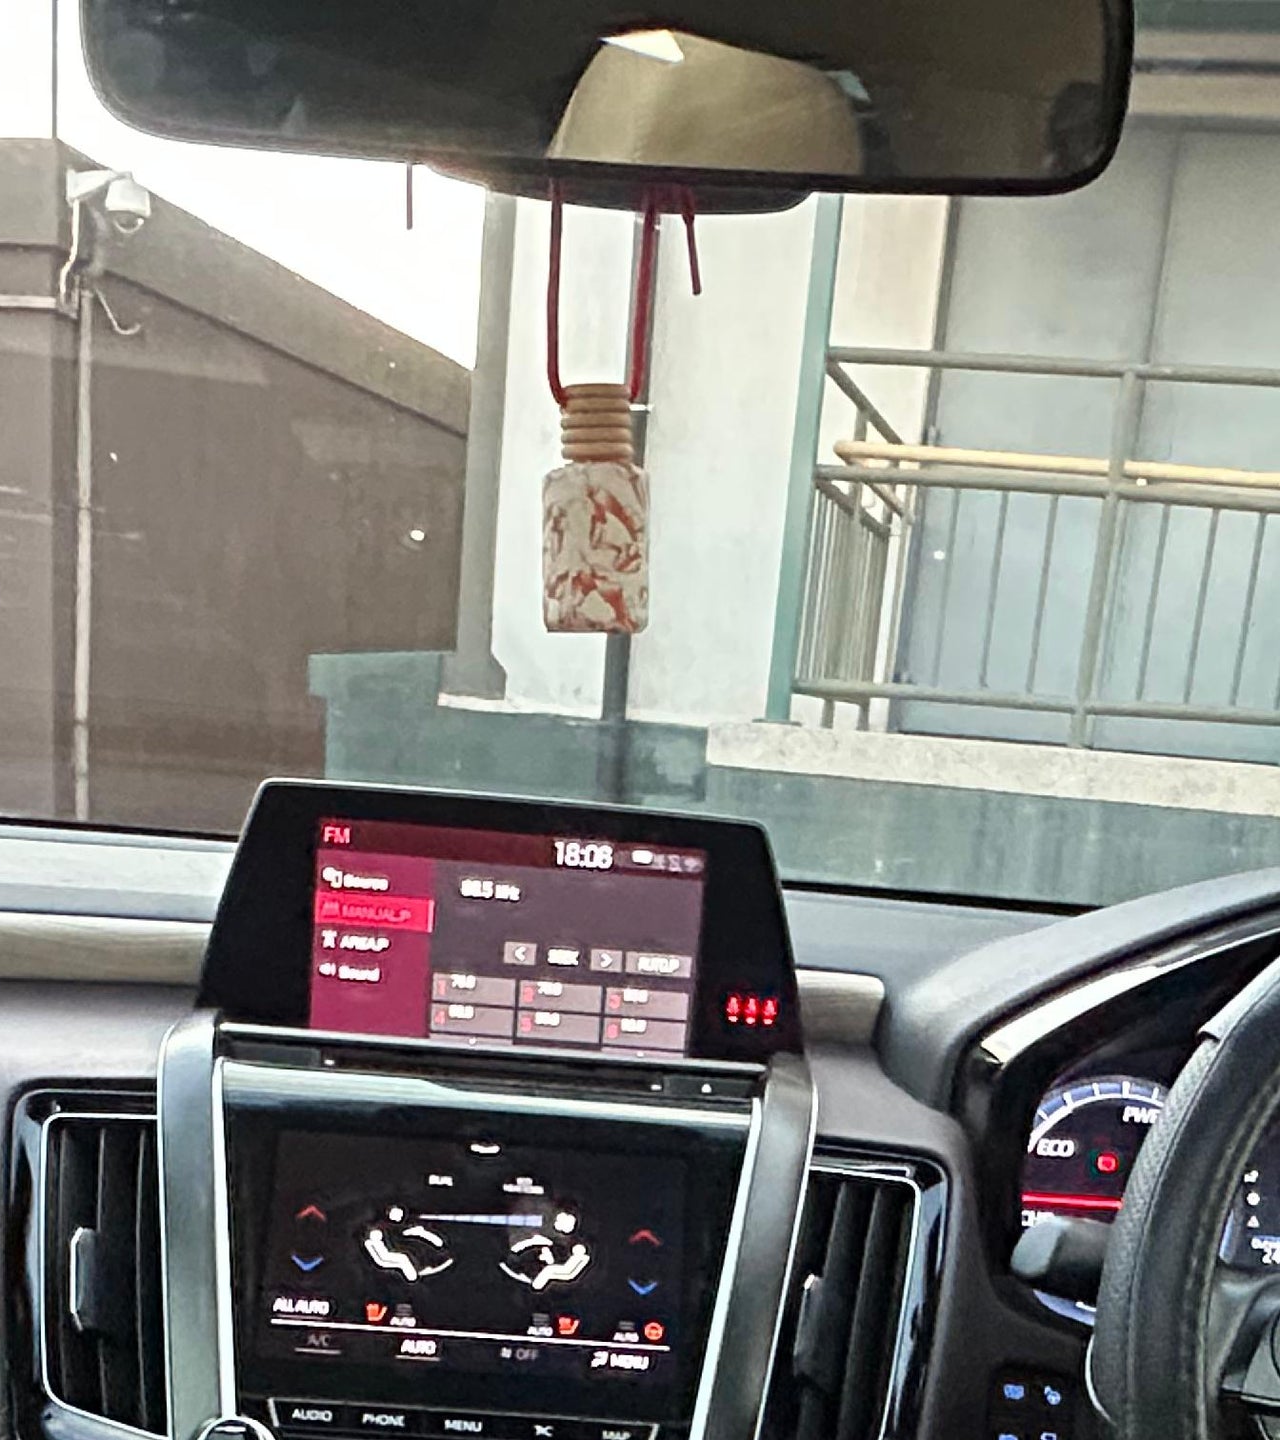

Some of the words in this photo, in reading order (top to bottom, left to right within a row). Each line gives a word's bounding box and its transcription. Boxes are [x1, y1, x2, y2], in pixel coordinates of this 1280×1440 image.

[323, 825, 352, 844] FM
[1036, 1138, 1075, 1158] ECO
[400, 1339, 437, 1355] AUTO
[292, 1408, 333, 1422] AUDIO
[362, 1413, 406, 1427] PHONE
[444, 1419, 483, 1432] MENU
[602, 1430, 632, 1440] MAP
